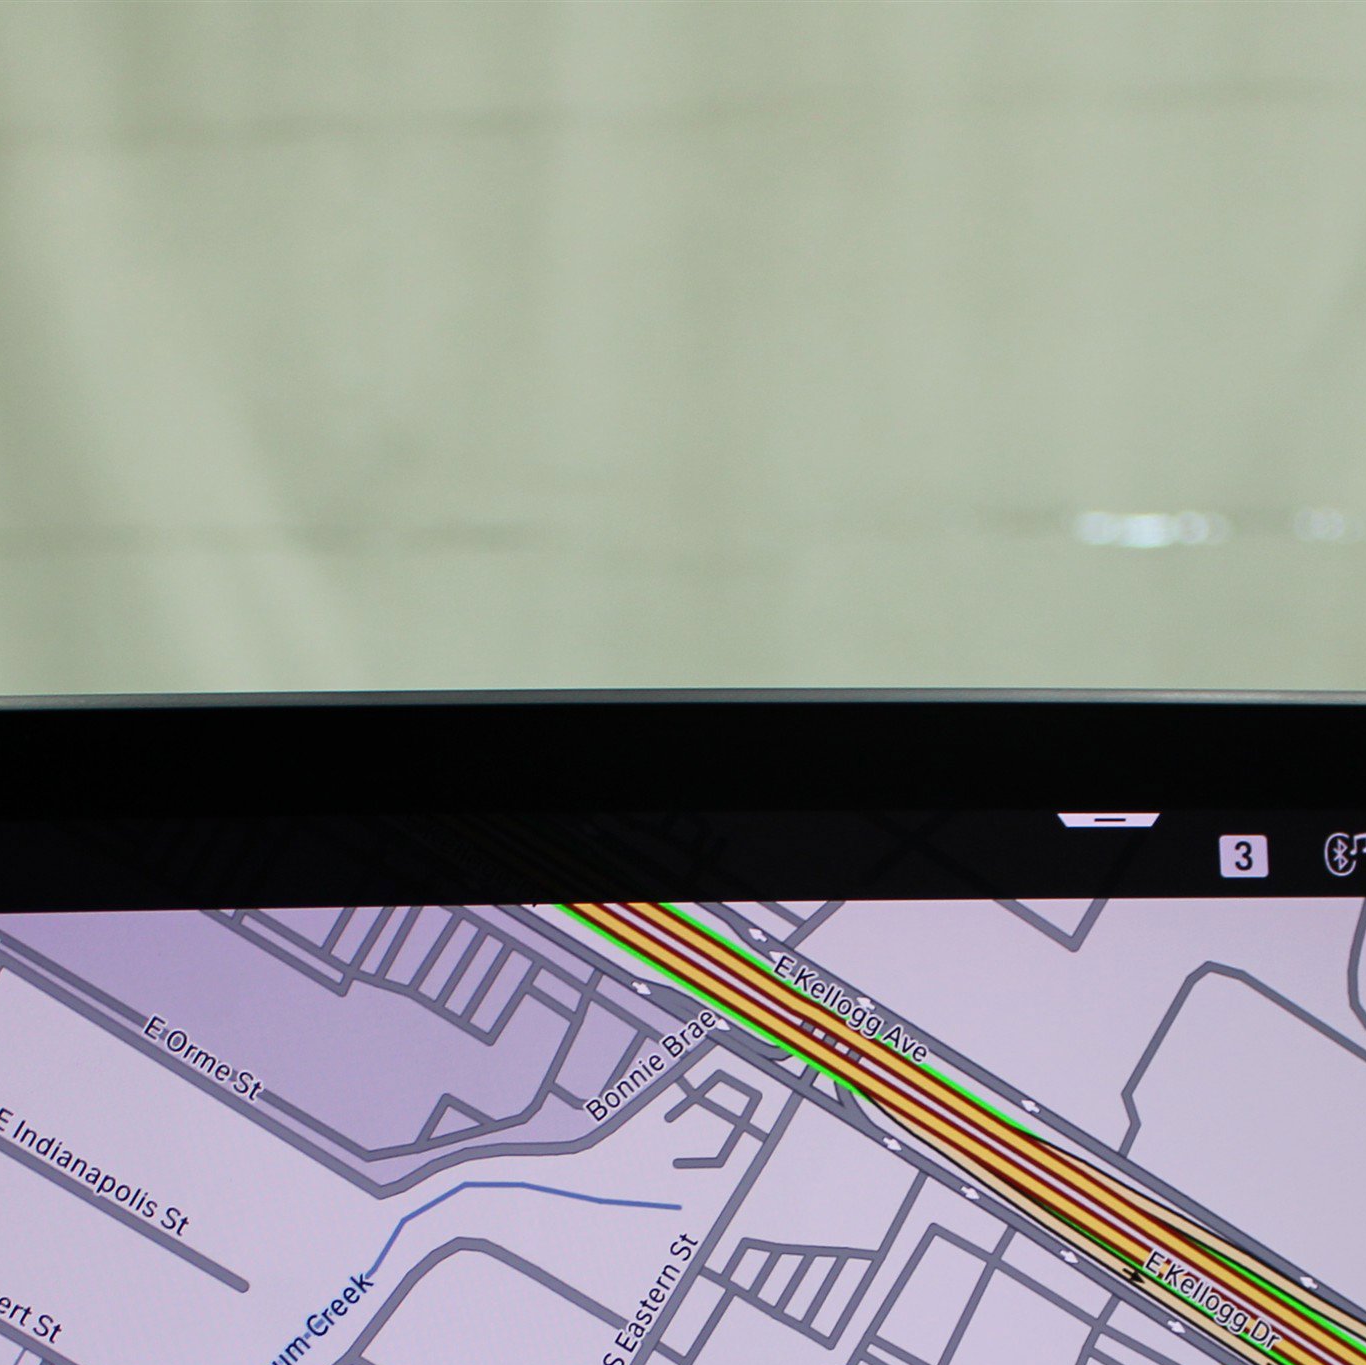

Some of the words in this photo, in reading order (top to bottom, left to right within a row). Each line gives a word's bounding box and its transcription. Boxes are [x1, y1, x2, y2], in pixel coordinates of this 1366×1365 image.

[1234, 842, 1254, 871] 3
[143, 1015, 164, 1040] E
[166, 1030, 232, 1081] Orme
[233, 1073, 264, 1102] St
[773, 956, 795, 980] E
[794, 969, 881, 1038] Kellogg
[883, 1026, 928, 1063] Ave
[585, 1048, 665, 1122] Bonnie
[662, 1008, 717, 1057] Brae
[14, 1118, 159, 1222] Indianapolis
[163, 1209, 191, 1237] St
[34, 1318, 64, 1344] St
[306, 1273, 374, 1338] Creek
[615, 1265, 681, 1352] Eastern
[669, 1232, 699, 1262] St
[1143, 1251, 1164, 1276] E
[1163, 1263, 1251, 1336] Kellogg
[1249, 1316, 1280, 1350] Dr
